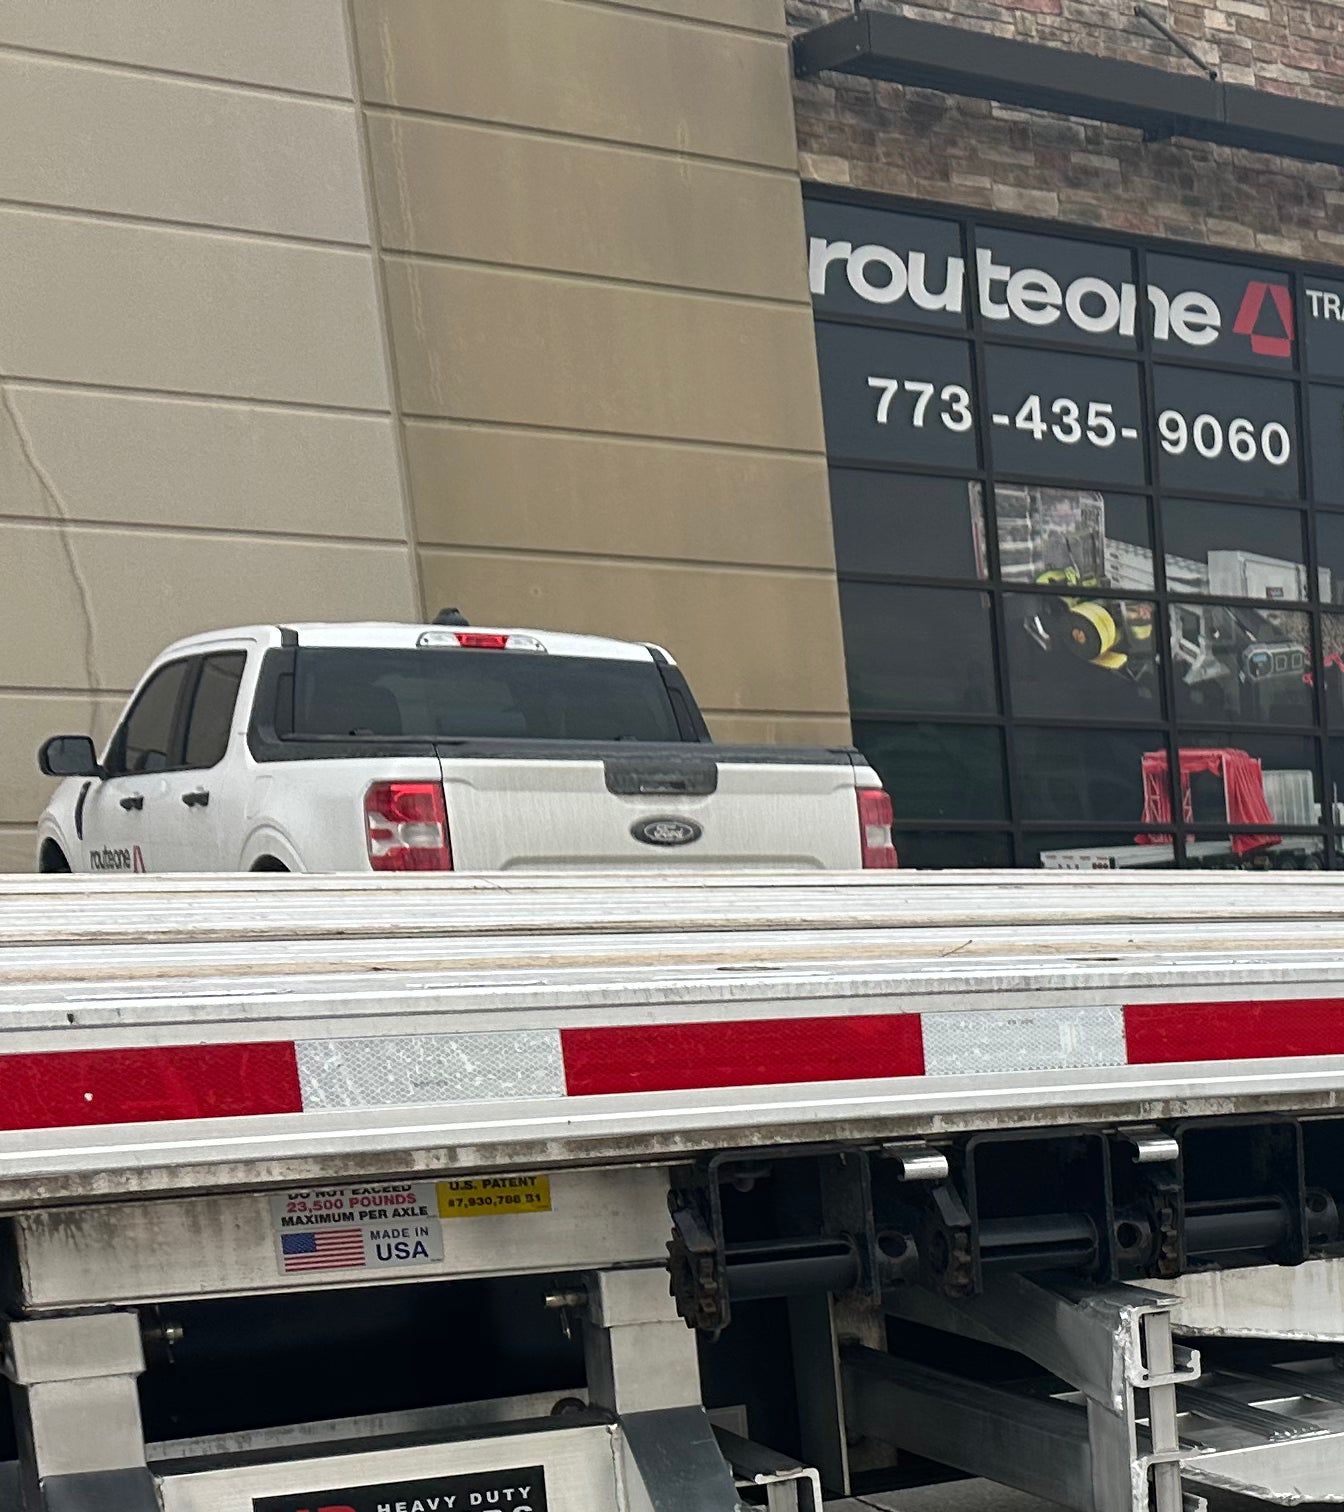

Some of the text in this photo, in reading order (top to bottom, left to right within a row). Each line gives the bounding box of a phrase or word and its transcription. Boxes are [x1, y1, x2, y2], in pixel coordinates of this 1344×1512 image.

[809, 237, 1221, 346] routeone
[653, 823, 685, 841] Ford
[351, 1184, 412, 1196] EXCEED
[449, 1175, 538, 1191] U.S. PATENT
[286, 1193, 417, 1214] 23,500 POUNDS
[281, 1206, 428, 1227] MAXIMUM PER AXLE
[370, 1226, 429, 1241] MADE IN
[375, 1241, 430, 1262] USA
[469, 1485, 532, 1506] DUTY
